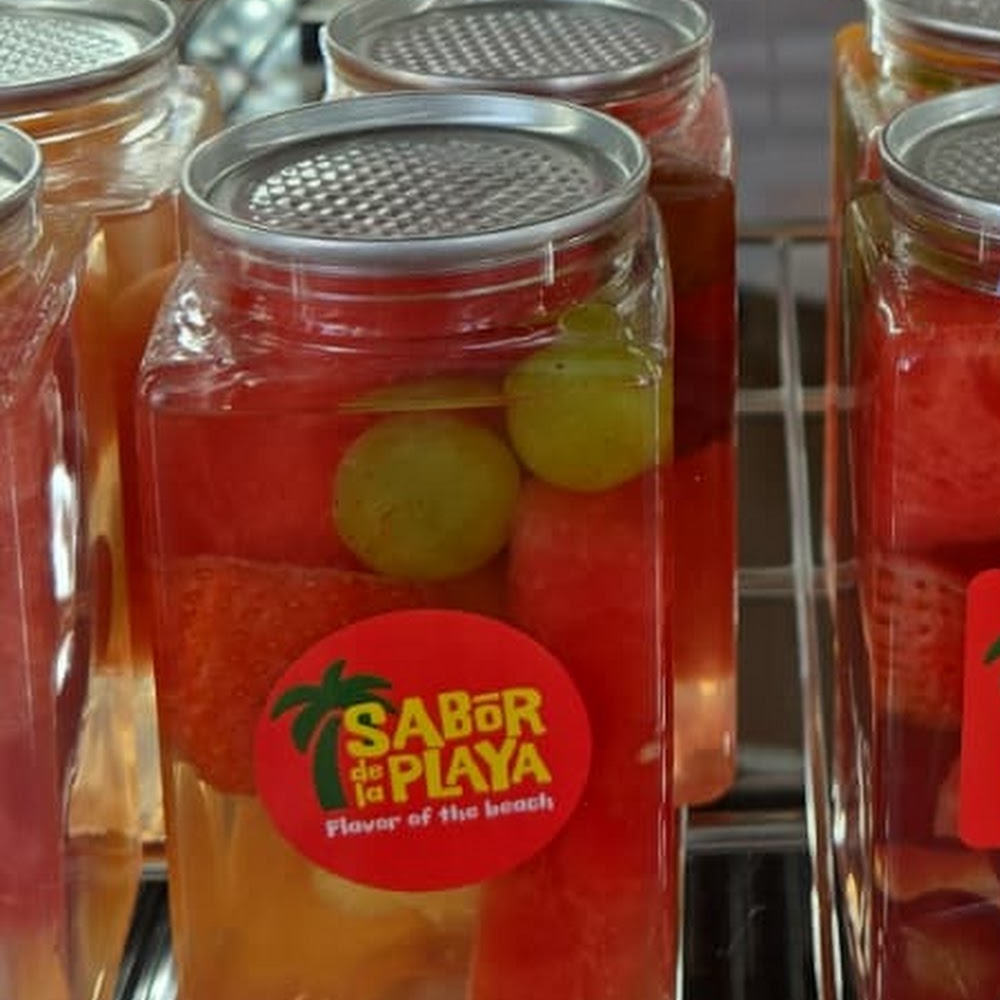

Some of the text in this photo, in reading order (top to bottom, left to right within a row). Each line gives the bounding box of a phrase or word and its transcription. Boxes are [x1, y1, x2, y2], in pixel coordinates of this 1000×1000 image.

[350, 760, 383, 782] de
[355, 738, 552, 808] la PLAYA
[325, 793, 554, 839] Flavor of the beach
